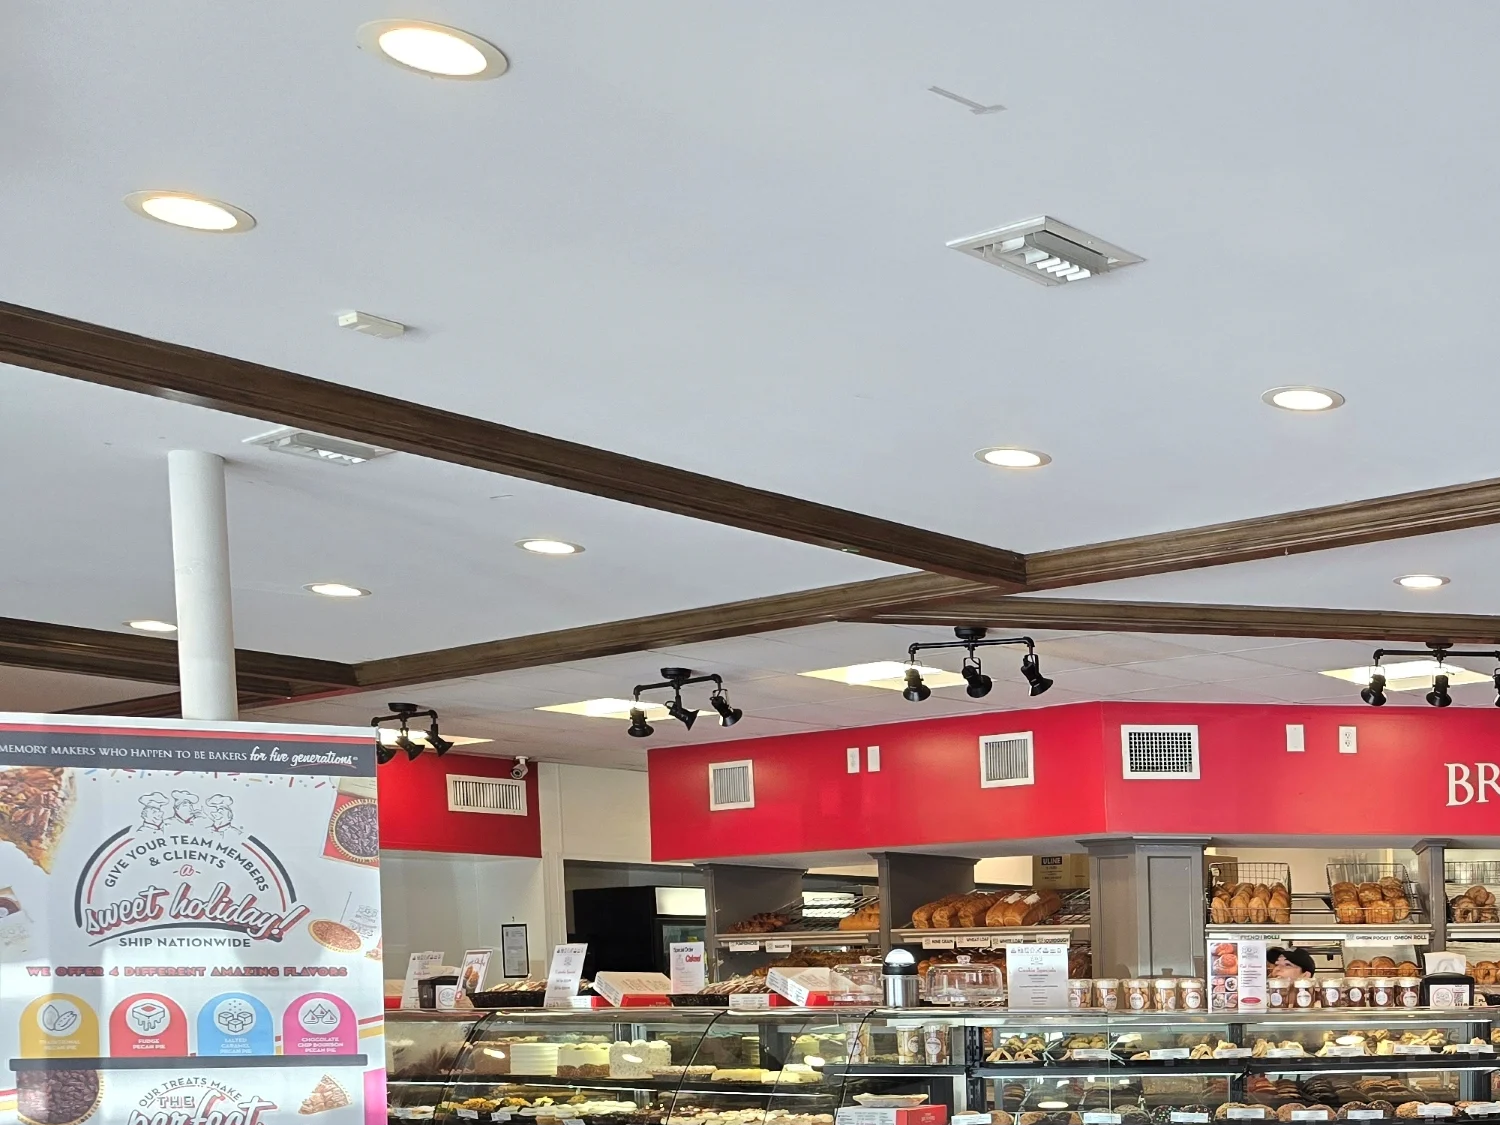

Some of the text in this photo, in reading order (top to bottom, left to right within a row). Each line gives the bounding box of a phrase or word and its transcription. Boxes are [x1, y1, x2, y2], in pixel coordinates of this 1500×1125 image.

[0, 744, 48, 754] MEMORY
[51, 746, 95, 756] MAKERS
[99, 747, 127, 757] WHO
[131, 749, 173, 758] HAPPEN
[175, 750, 191, 759] TO
[194, 750, 205, 760] BE
[209, 751, 248, 761] BAKERS
[250, 746, 267, 761] for
[269, 747, 289, 762] five
[104, 835, 270, 893] GIVE YOUR TEAM MEMBERS
[149, 849, 227, 870] & CLIENTS
[85, 882, 310, 941] sweet holiday!
[119, 938, 251, 948] SHIP NATIONWIDE
[26, 966, 348, 977] WE OFFER 4 DIFFERENT AMAZING FLAVORS
[139, 1077, 242, 1107] OUR TREATS MAKE
[157, 1096, 195, 1109] THE
